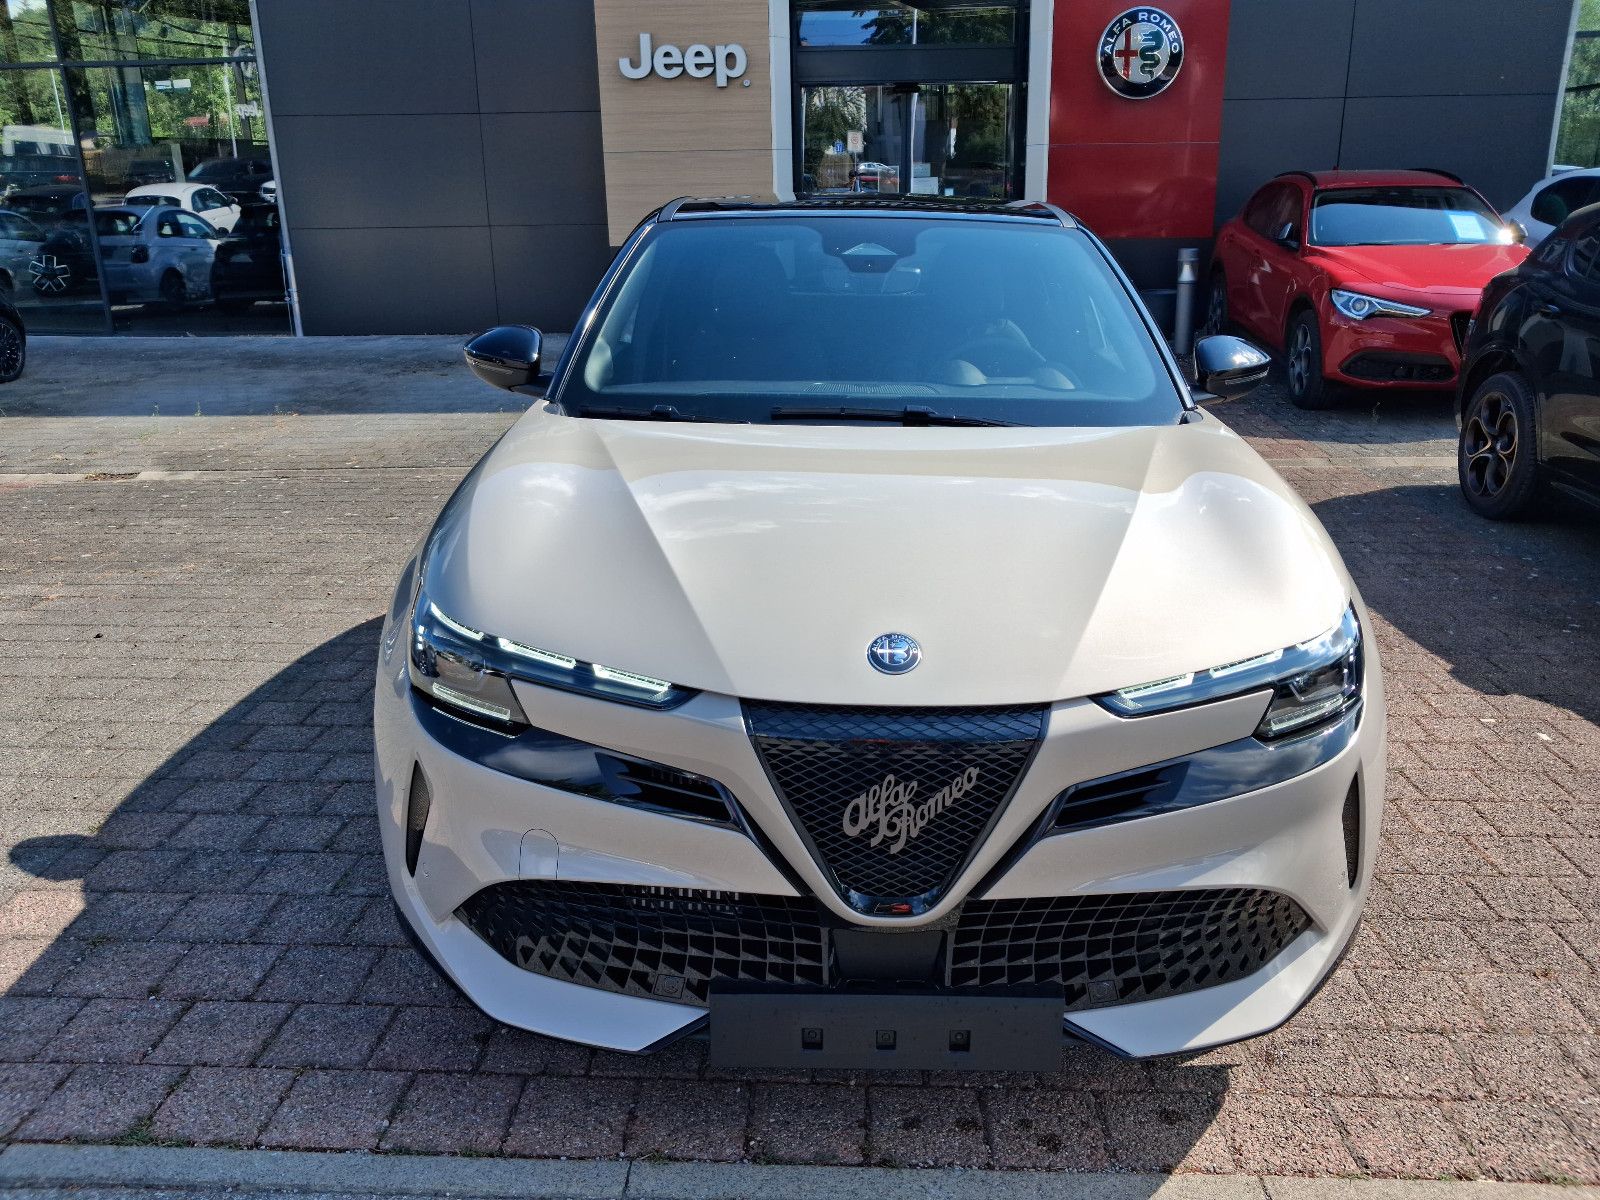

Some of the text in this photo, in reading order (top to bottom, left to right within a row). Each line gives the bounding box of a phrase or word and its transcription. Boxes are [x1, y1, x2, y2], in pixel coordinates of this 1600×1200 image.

[618, 32, 748, 88] Jeep
[1104, 12, 1180, 55] ALFA ROMEO
[842, 773, 918, 848] Alfa
[885, 766, 980, 855] Romeo
